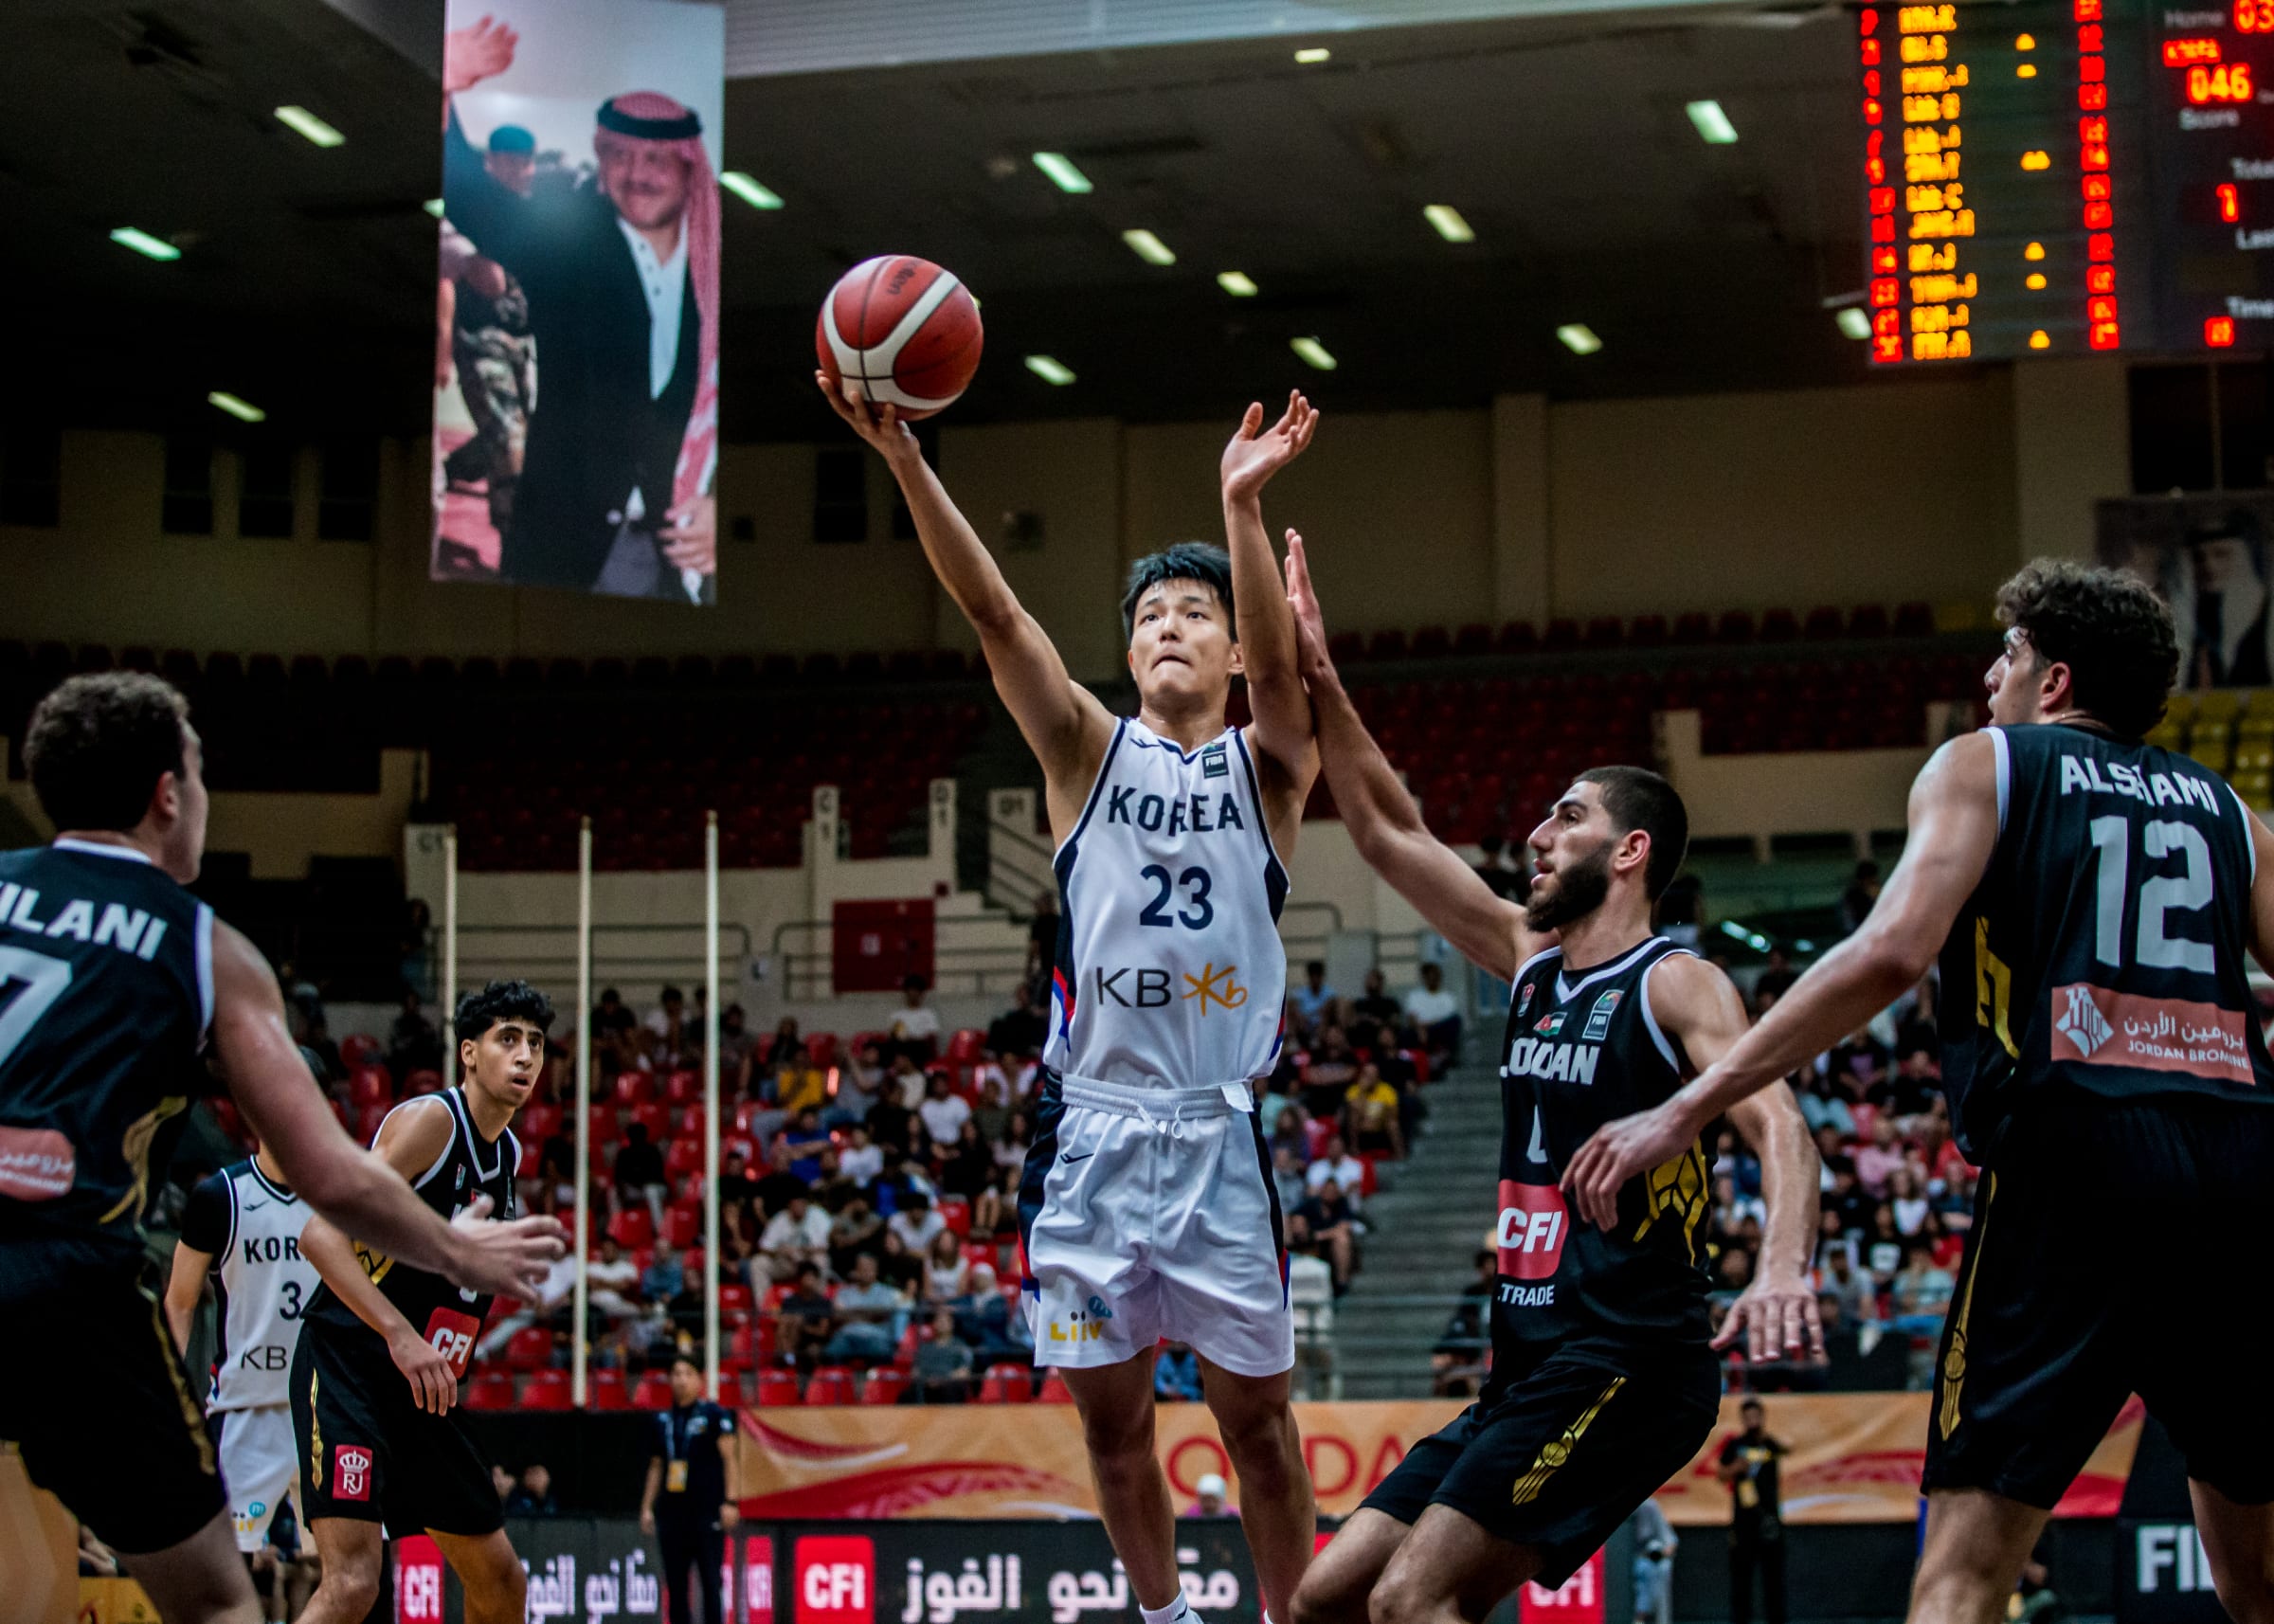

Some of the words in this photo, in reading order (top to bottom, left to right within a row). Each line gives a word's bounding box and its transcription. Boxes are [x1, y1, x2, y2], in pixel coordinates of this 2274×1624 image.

[2179, 107, 2239, 130] Score
[1108, 785, 1245, 837] KOREA
[1139, 864, 1215, 930] 23
[2090, 815, 2215, 975] 12
[0, 881, 169, 962] ILANI
[1095, 966, 1172, 1008] KB
[2128, 1040, 2185, 1061] JORDAN
[2189, 1049, 2249, 1071] BROMINE
[244, 1236, 309, 1264] KOR
[1497, 1207, 1562, 1253] CFI
[279, 1280, 301, 1321] 3
[241, 1345, 287, 1371] KB
[431, 1326, 472, 1365] CFI
[343, 1472, 363, 1495] RJ
[405, 1564, 440, 1618] CFI
[804, 1563, 866, 1610] CFI
